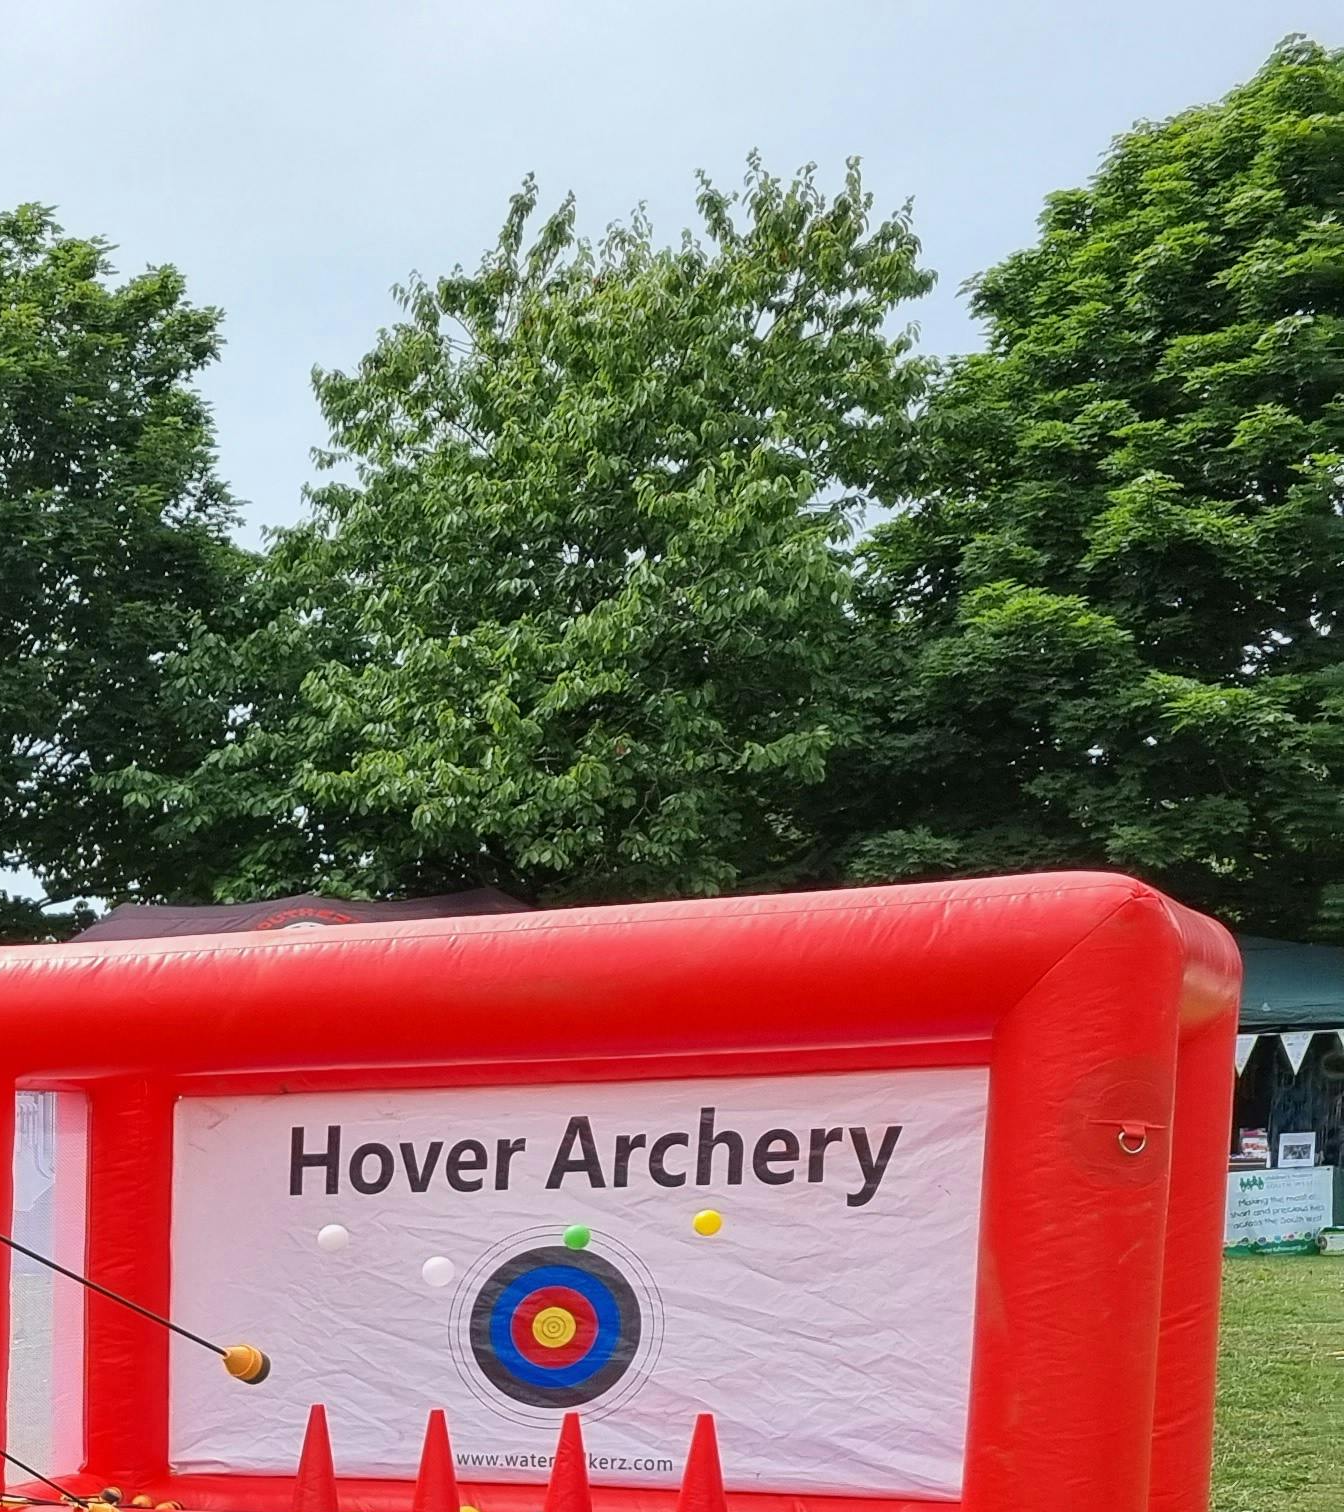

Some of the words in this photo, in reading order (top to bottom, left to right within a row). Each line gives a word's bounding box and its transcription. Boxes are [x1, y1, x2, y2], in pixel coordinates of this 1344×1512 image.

[288, 1124, 527, 1196] Hover
[544, 1106, 903, 1208] Archery
[456, 1452, 673, 1471] www.waterkerz.com
